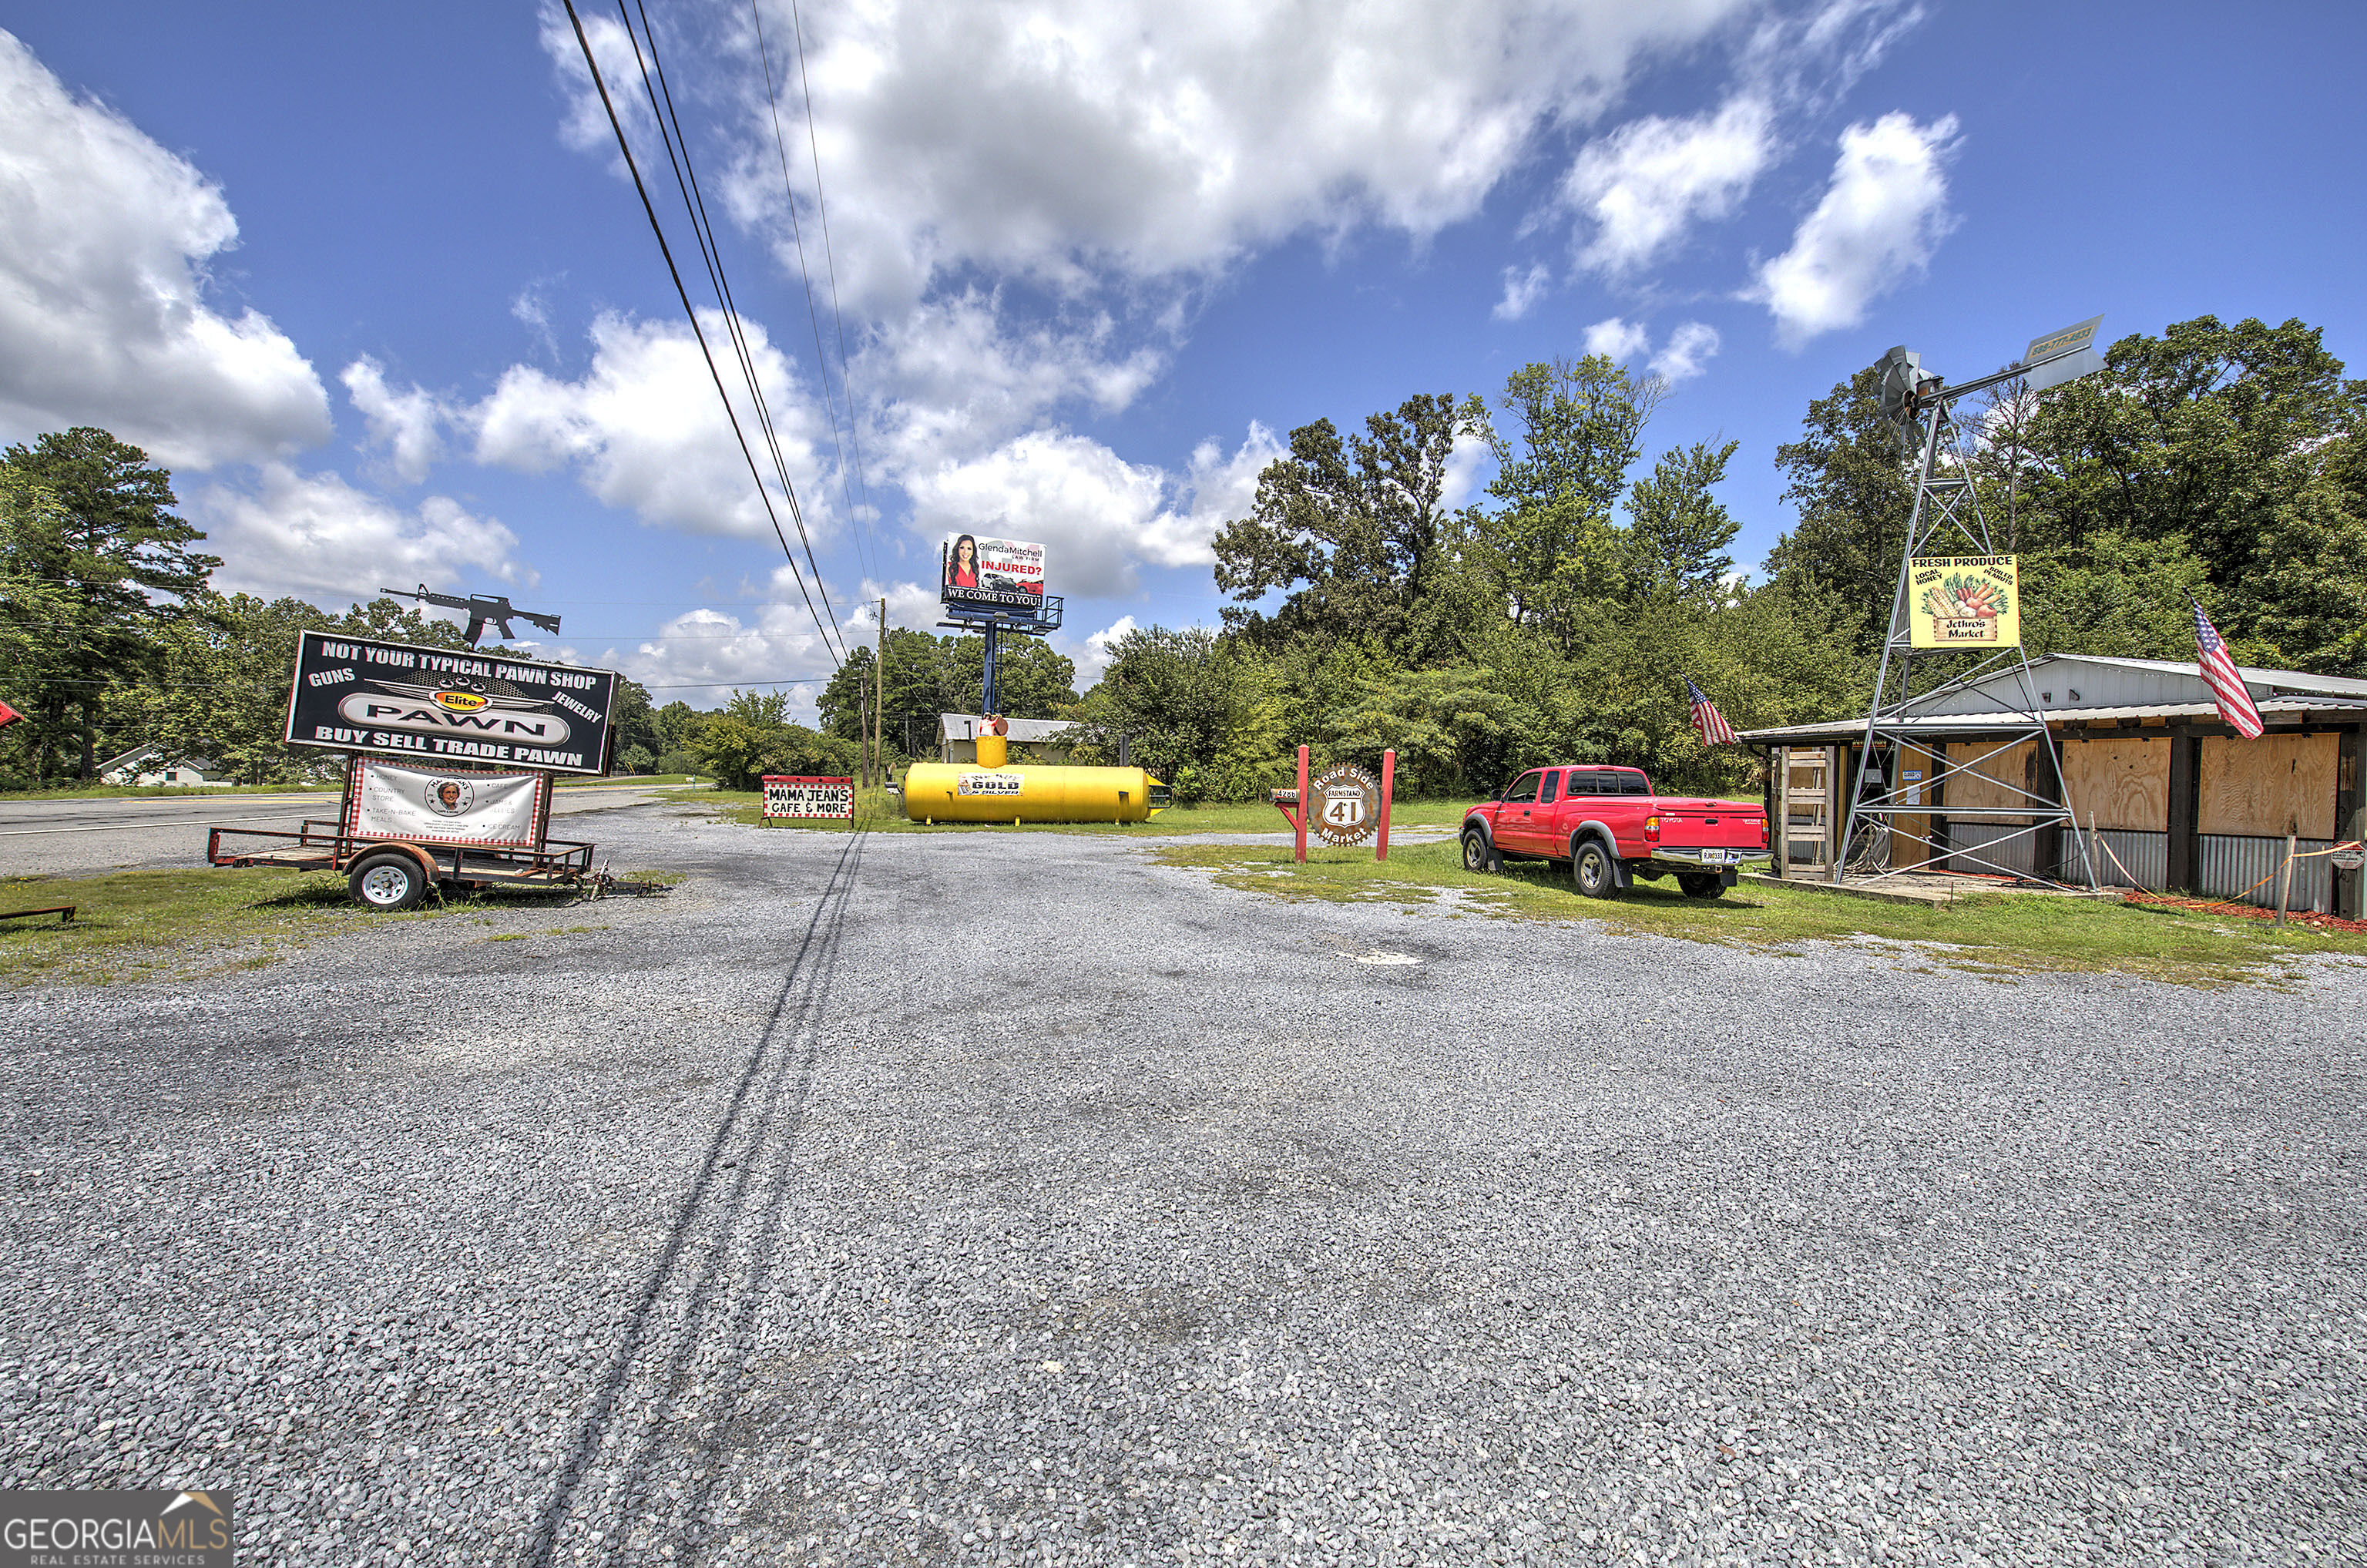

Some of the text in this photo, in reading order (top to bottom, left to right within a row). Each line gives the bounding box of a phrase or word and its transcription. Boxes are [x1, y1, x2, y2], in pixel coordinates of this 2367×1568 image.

[981, 560, 1042, 576] INJURED?
[1912, 556, 2013, 567] FRESH PRODUCE
[1915, 569, 1940, 580] LOCAL
[1915, 573, 1942, 586] HONEY
[1983, 569, 2013, 586] PEANUTS
[1989, 566, 2013, 579] BOILED
[948, 588, 965, 598] WE
[966, 590, 998, 602] COME
[999, 594, 1014, 603] TO
[1016, 596, 1042, 606] YOU!
[1946, 619, 1986, 629] Jethro's
[1948, 630, 1984, 638] Market
[322, 641, 596, 690] NOT YOUR TYPICAL PAWN SHOP
[308, 667, 355, 687] GUNS
[445, 695, 477, 707] Elite
[552, 690, 603, 724] JEWELRY
[367, 704, 546, 737] PAWN
[314, 726, 583, 767] BUY SELL TRADE PAWN
[1313, 767, 1374, 791] Road Side
[769, 789, 848, 801] MAMA JEAN'S
[372, 808, 416, 816] TAKE-N-BAKE
[772, 802, 847, 813] CAFE & MORE
[1330, 801, 1356, 821] 41
[1321, 828, 1367, 843] Market
